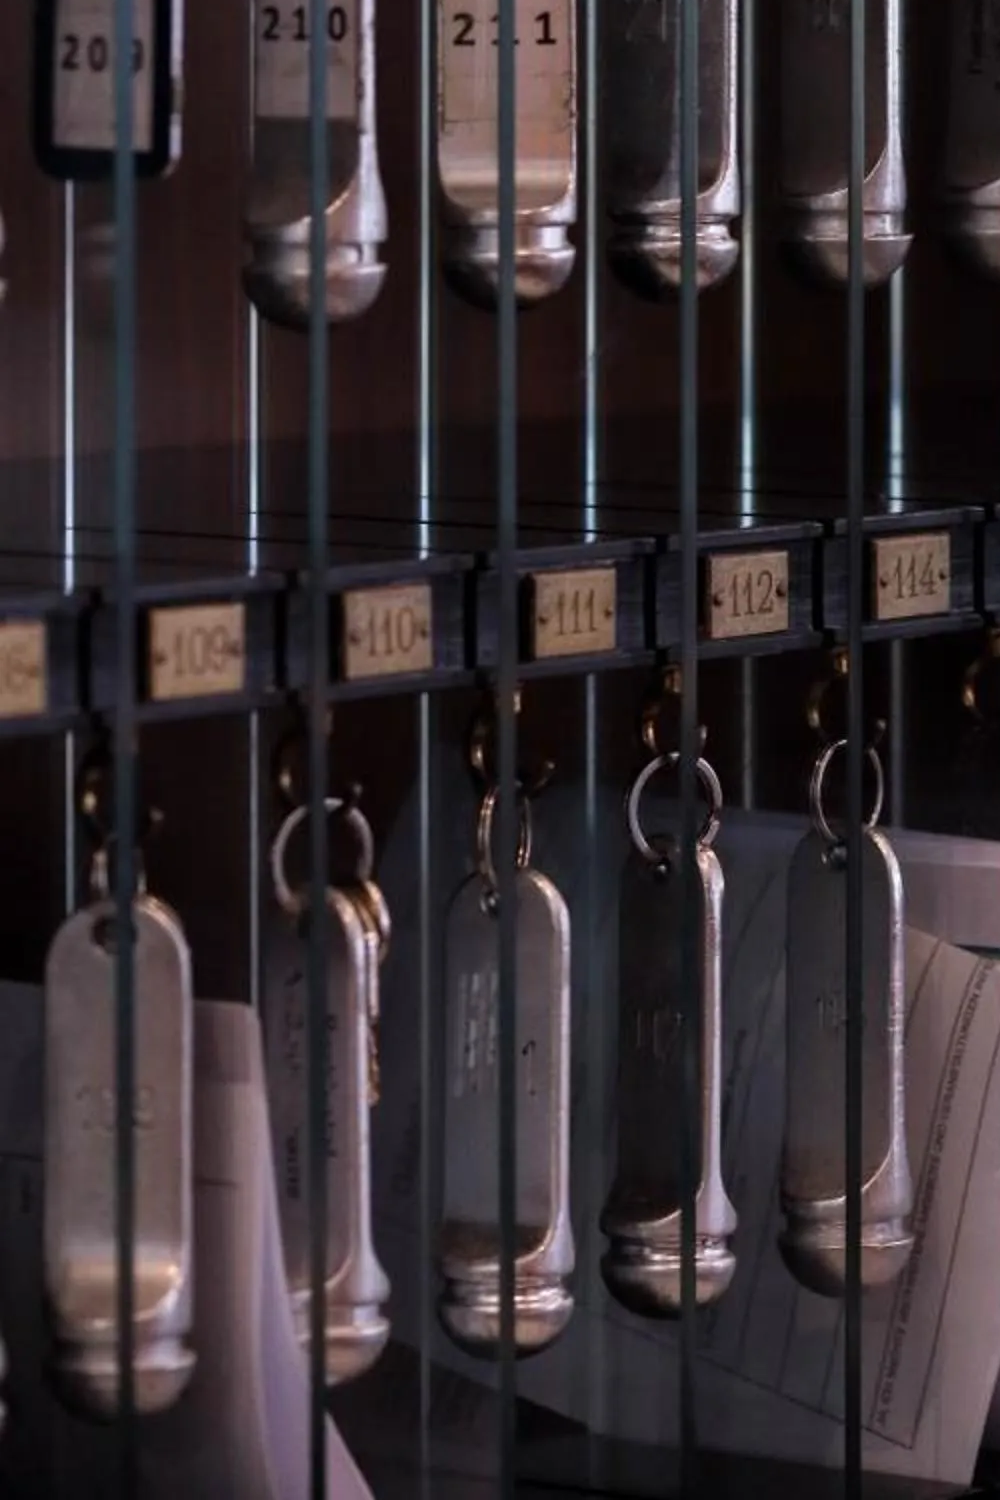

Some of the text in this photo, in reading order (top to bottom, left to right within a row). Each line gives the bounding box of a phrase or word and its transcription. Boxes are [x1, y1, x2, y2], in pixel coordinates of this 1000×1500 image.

[261, 6, 347, 42] 210
[452, 11, 557, 46] 21
[729, 569, 773, 619] 112
[893, 552, 936, 598] 114
[366, 605, 416, 657] 110
[556, 588, 597, 637] 111
[174, 625, 229, 676] 109
